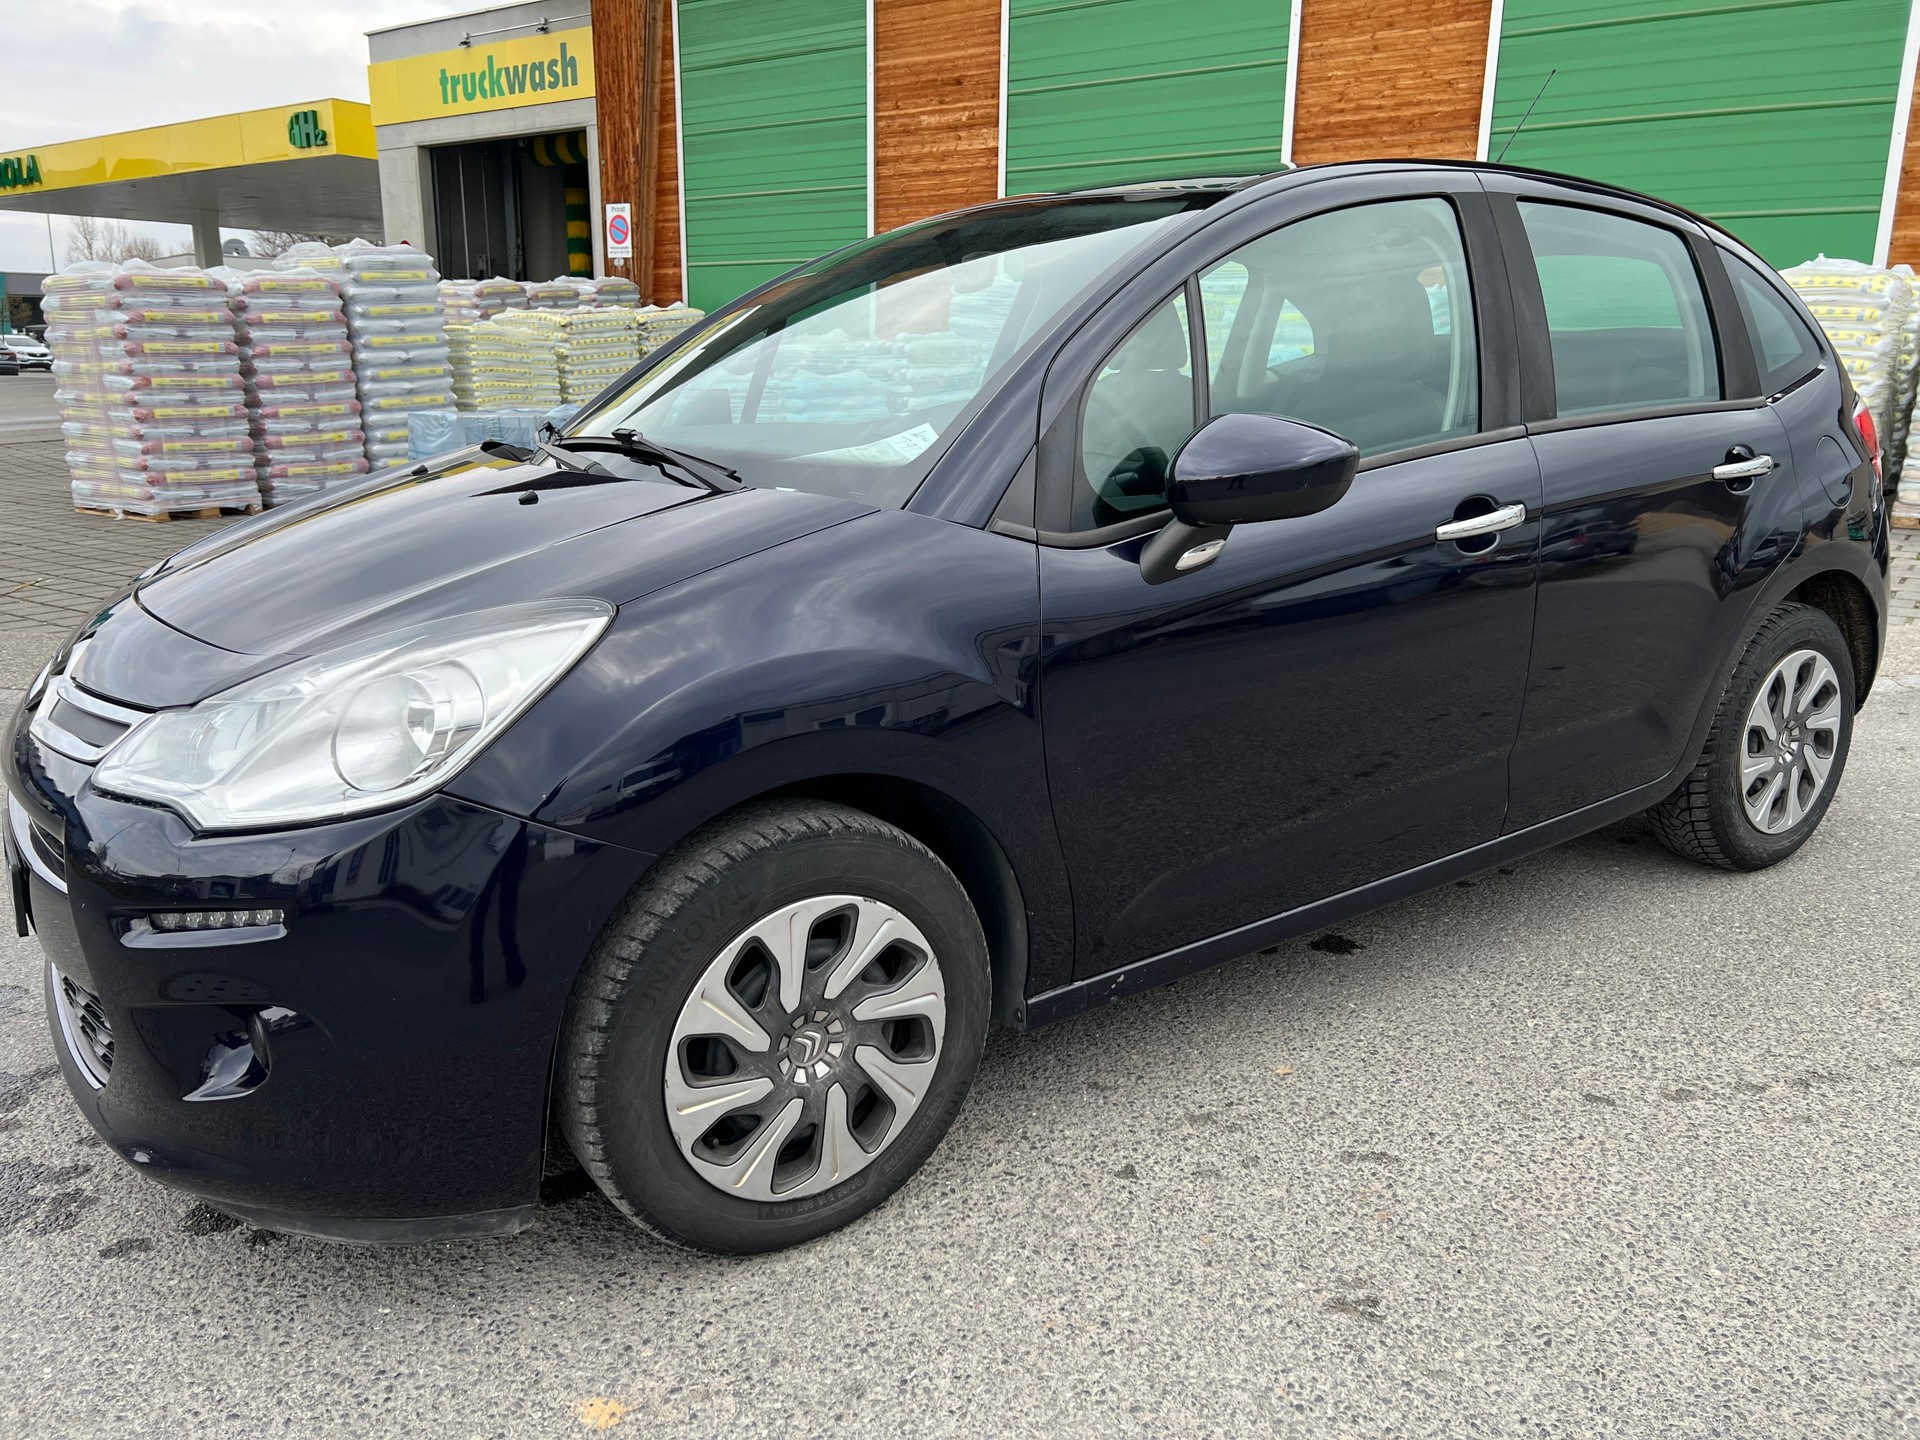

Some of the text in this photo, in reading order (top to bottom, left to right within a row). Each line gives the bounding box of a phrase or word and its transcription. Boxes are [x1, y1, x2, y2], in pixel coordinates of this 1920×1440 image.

[439, 42, 578, 104] truckwash
[0, 154, 43, 188] OLA
[1727, 669, 1762, 754] UNIROYAL
[640, 884, 752, 1015] UNIROYAL
